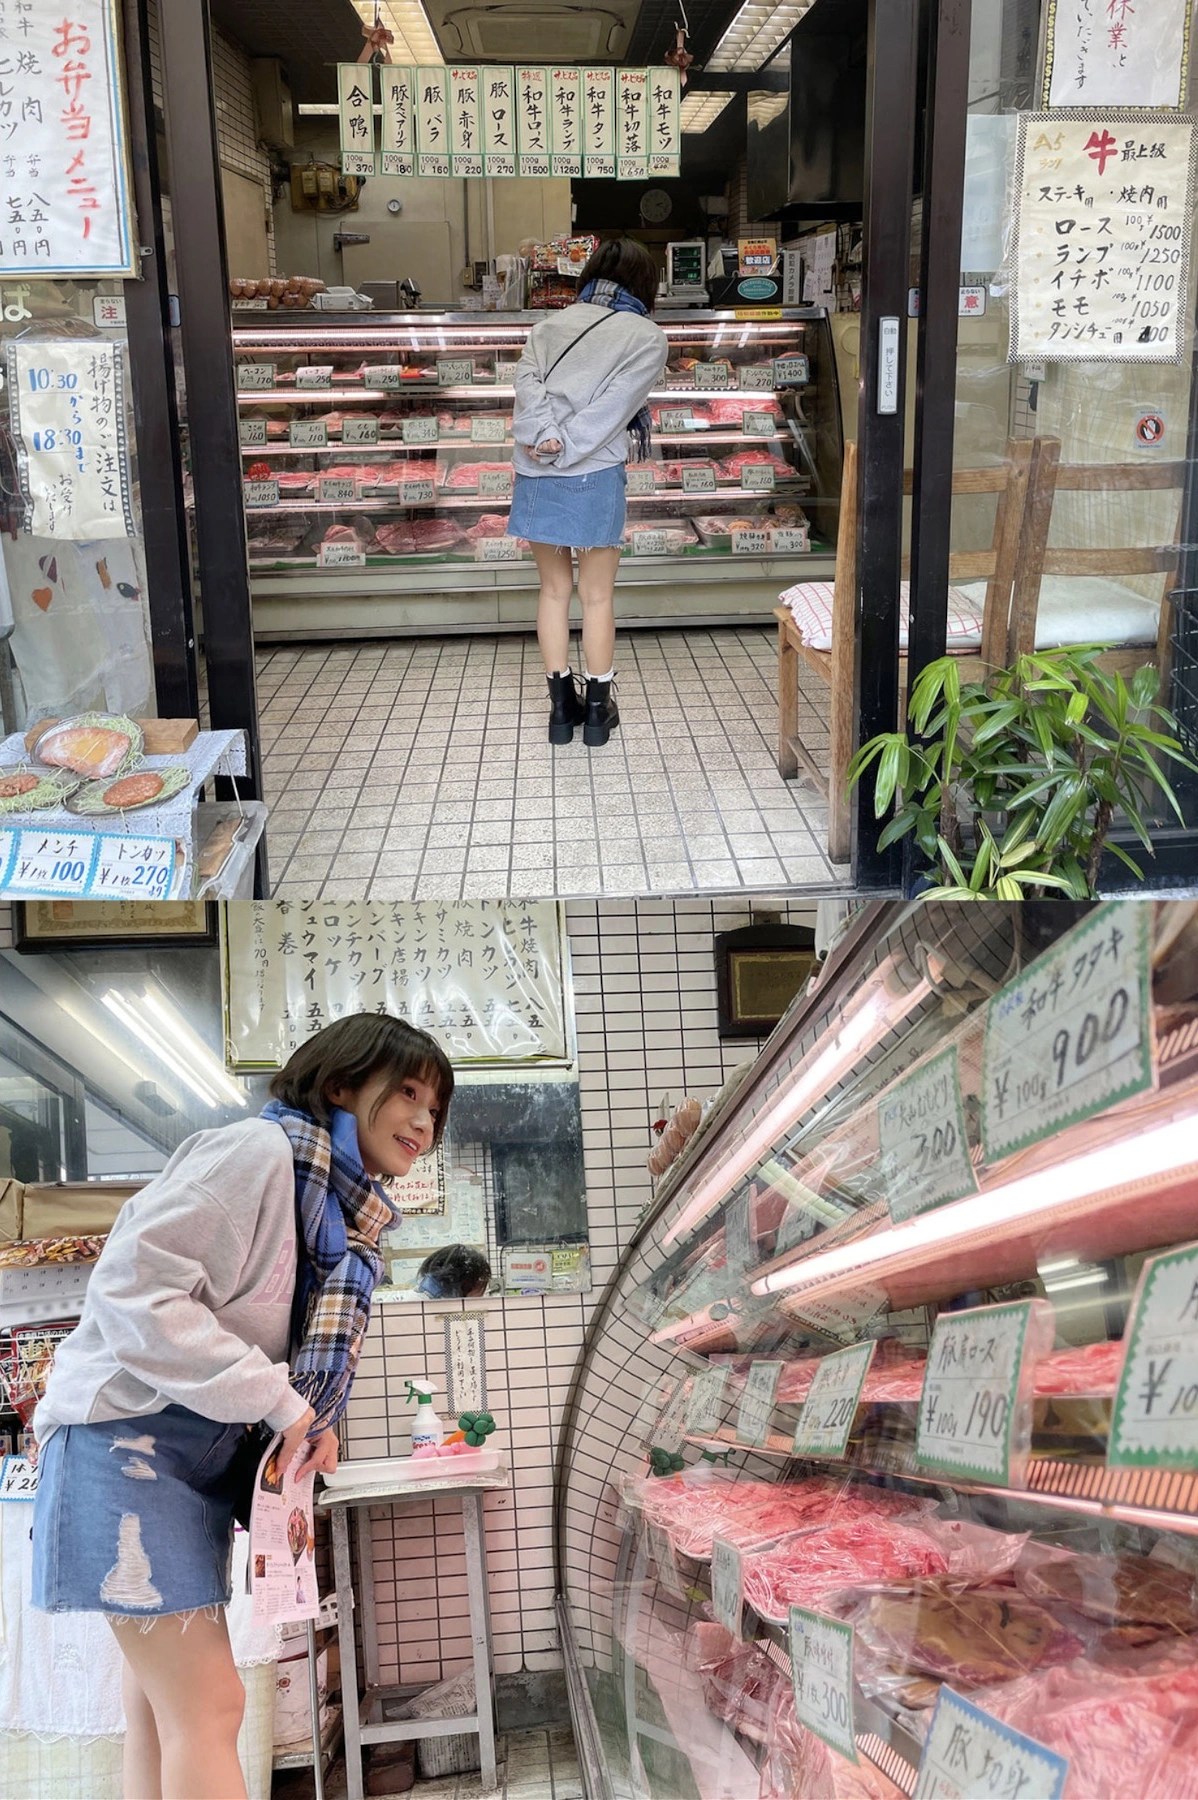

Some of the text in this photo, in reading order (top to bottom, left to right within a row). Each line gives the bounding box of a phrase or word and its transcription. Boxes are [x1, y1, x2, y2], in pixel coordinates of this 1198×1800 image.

[346, 85, 369, 139] 合鴨
[423, 86, 444, 143] 豚バラ
[457, 88, 476, 149] 豚赤身
[489, 81, 509, 146] 豚ロース
[522, 84, 544, 149] 和牛ロース
[586, 86, 606, 149] 和牛タン
[621, 88, 642, 154] 和牛切落
[652, 85, 673, 150] 和牛モツ
[51, 17, 101, 239] お弁当メニュー
[1034, 132, 1065, 151] A5
[1083, 130, 1118, 176] 牛
[1121, 141, 1168, 162] 最上級
[355, 164, 373, 173] 370
[465, 166, 482, 174] 220
[497, 166, 515, 174] 270
[597, 166, 614, 174] 750
[1055, 217, 1113, 236] ロース
[1149, 225, 1182, 241] 1500
[1140, 248, 1181, 264] 1250
[1051, 267, 1114, 291] イチボ
[1136, 274, 1175, 291] 1100
[101, 305, 118, 320] 注
[964, 295, 980, 309] 意
[1052, 296, 1090, 318] モモ
[1132, 301, 1170, 318] 1050
[884, 327, 897, 335] 自動
[28, 368, 78, 392] 10:30
[755, 378, 772, 387] 270
[787, 370, 803, 378] 400
[885, 347, 895, 397] 押して下さい
[33, 428, 82, 452] 18:30
[87, 352, 118, 512] 揚げ物のご注文は
[37, 838, 79, 855] メンチ
[117, 842, 166, 861] トンカツ
[50, 860, 84, 882] 100
[131, 865, 169, 886] 270
[993, 1071, 1009, 1120] ¥
[1052, 987, 1129, 1088] 900
[1138, 1357, 1173, 1416] ¥
[823, 1396, 855, 1430] 220
[926, 1394, 939, 1434] ¥
[964, 1390, 1008, 1440] 190
[823, 1681, 848, 1730] 300
